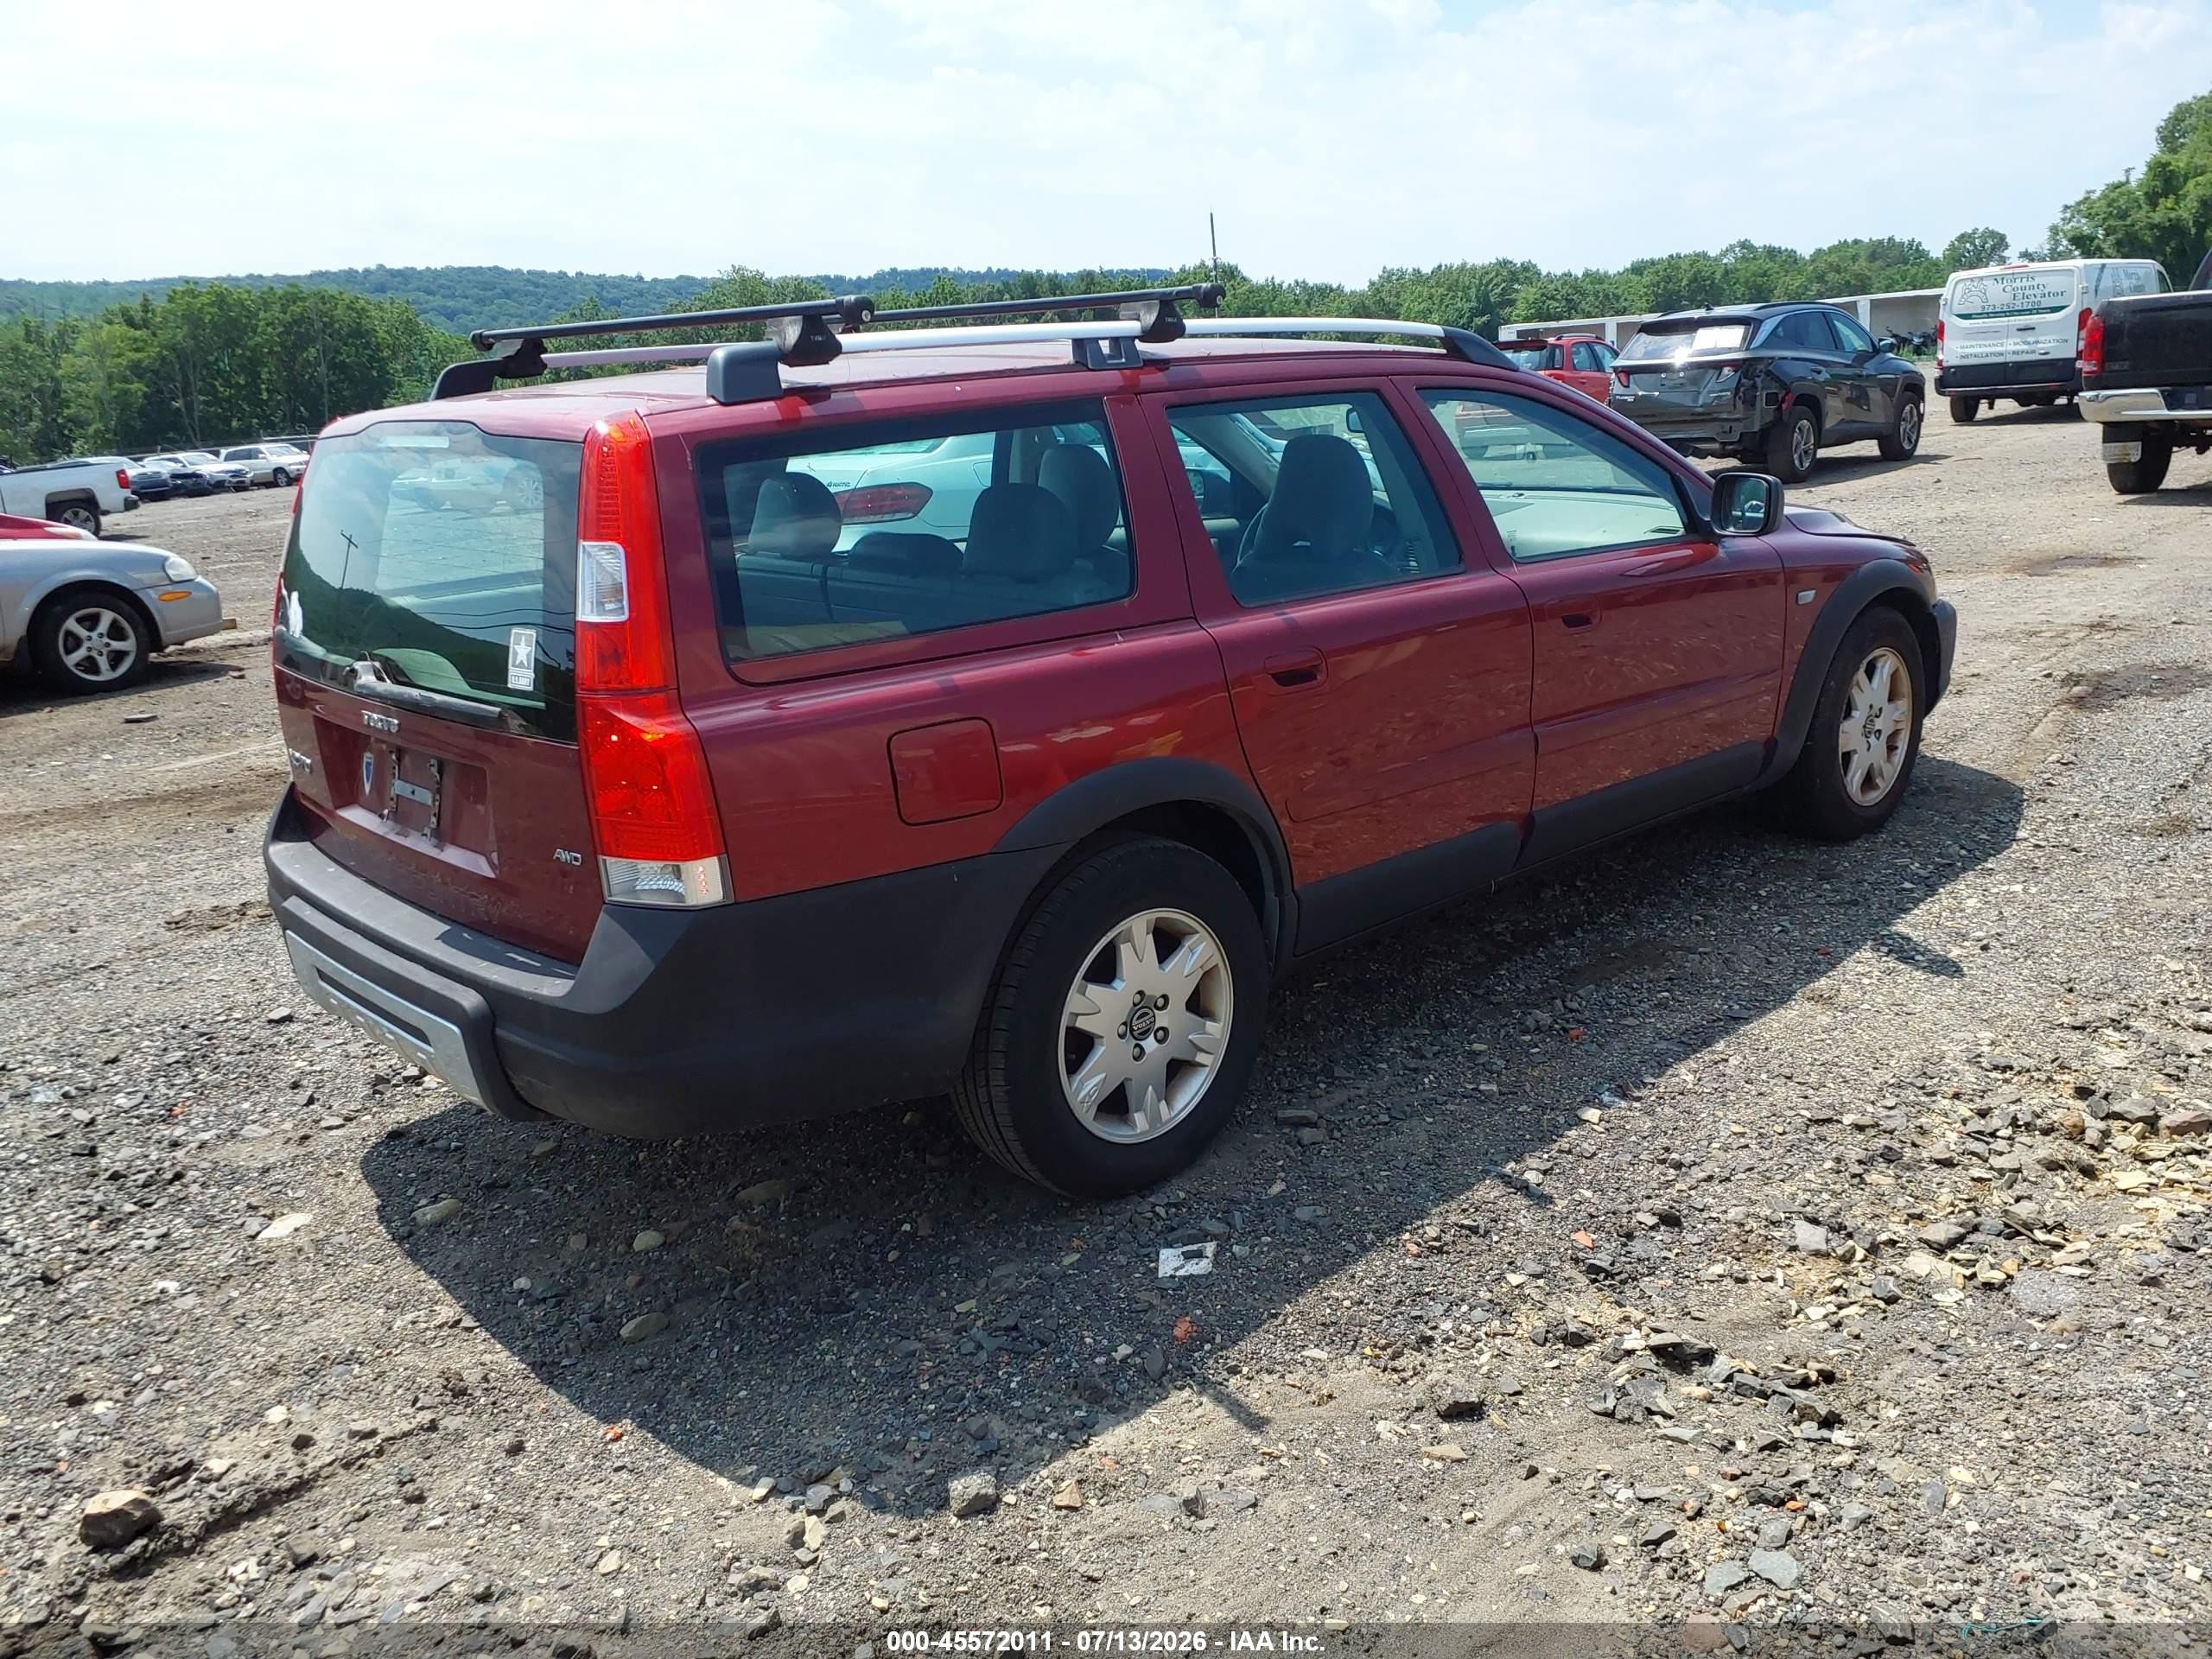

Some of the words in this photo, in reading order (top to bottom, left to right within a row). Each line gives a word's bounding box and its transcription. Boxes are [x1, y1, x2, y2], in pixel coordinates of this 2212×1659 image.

[1993, 274, 2036, 285] Morris
[2002, 284, 2047, 293] County
[2012, 290, 2066, 301] Elevator
[553, 849, 582, 867] AWD
[1132, 1016, 1155, 1031] VOLVO
